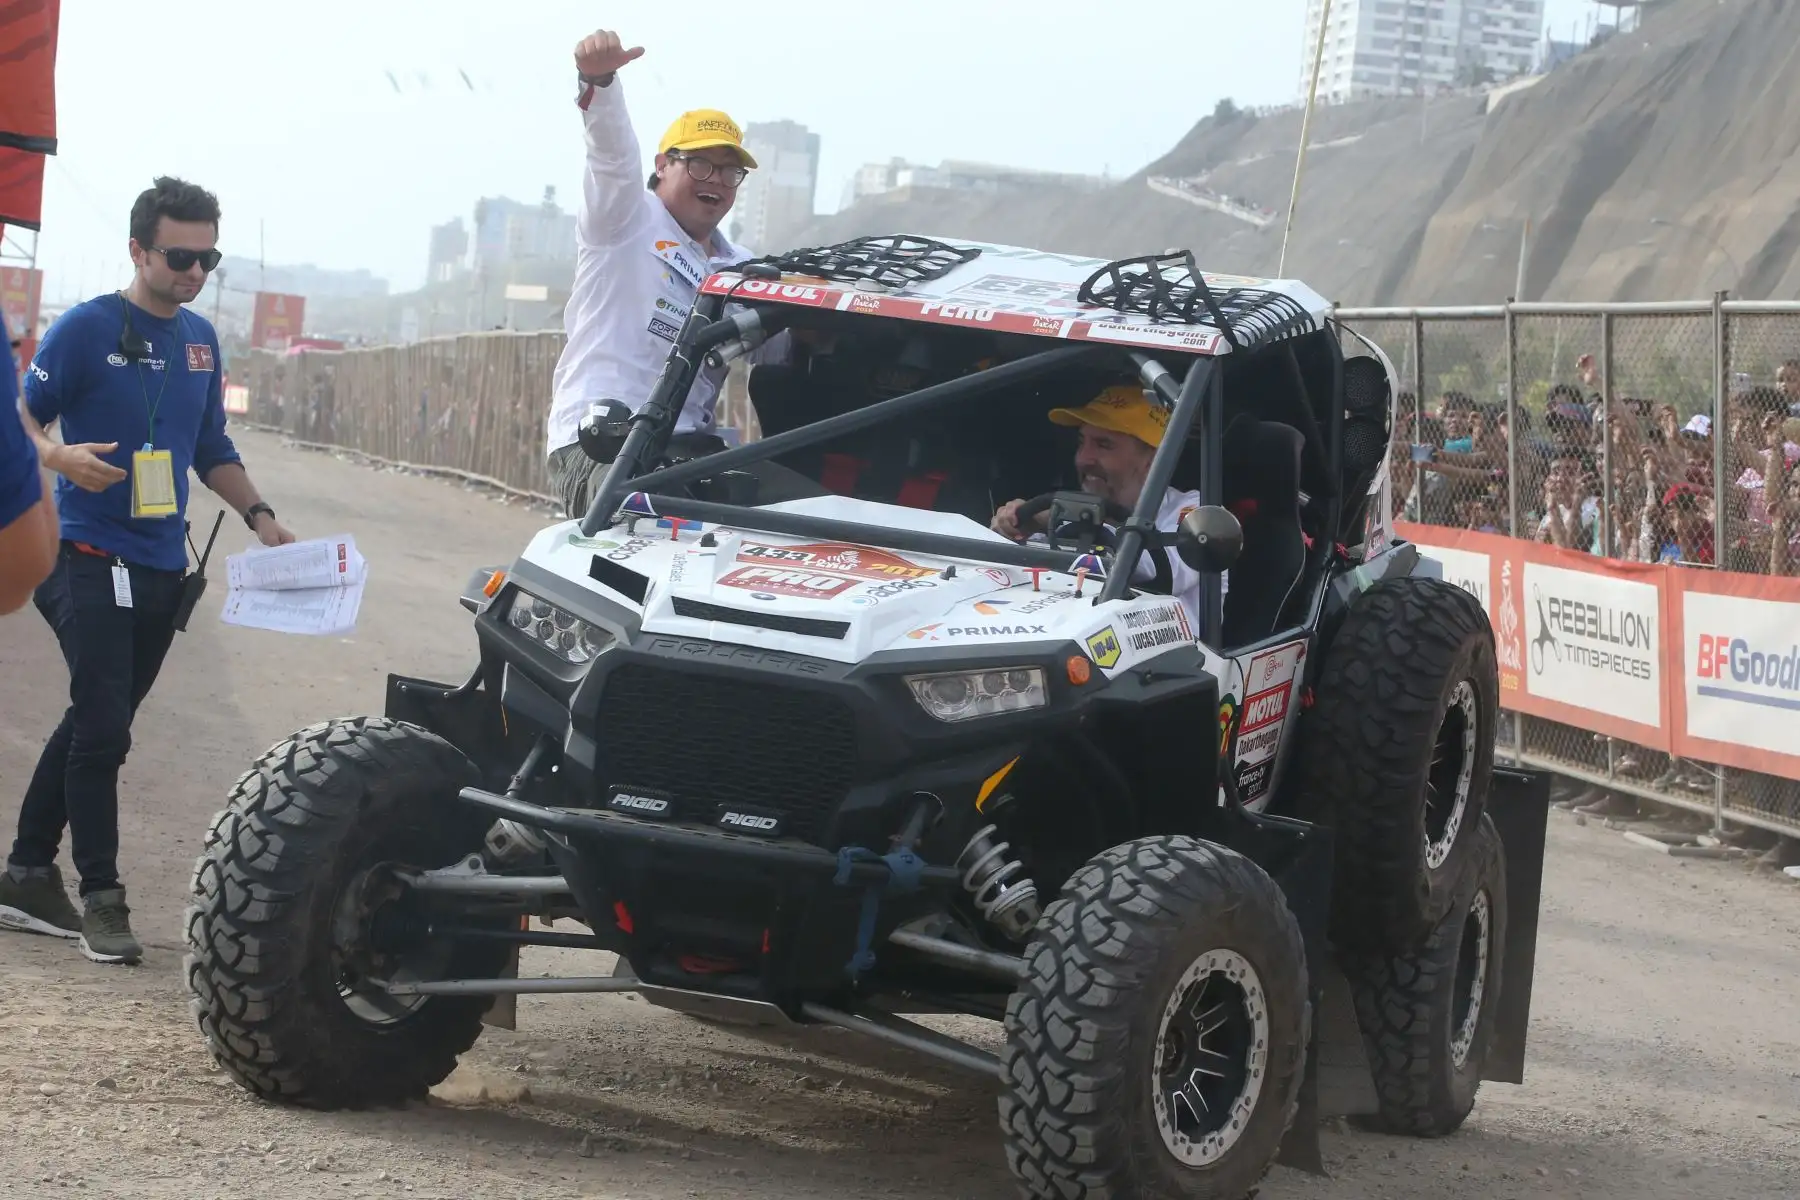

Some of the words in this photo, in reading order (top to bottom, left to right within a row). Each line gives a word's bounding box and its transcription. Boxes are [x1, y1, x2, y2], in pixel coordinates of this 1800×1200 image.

[674, 252, 702, 283] PRIM
[712, 277, 818, 299] MOTUL
[744, 546, 809, 561] 433
[736, 567, 846, 590] PRO
[947, 625, 1048, 636] PRIMAX
[1549, 597, 1651, 650] REBELLION
[1132, 629, 1155, 650] LUCAS
[1245, 690, 1285, 726] MOTUL
[611, 793, 668, 812] RIGID
[721, 811, 779, 830] RIGID
